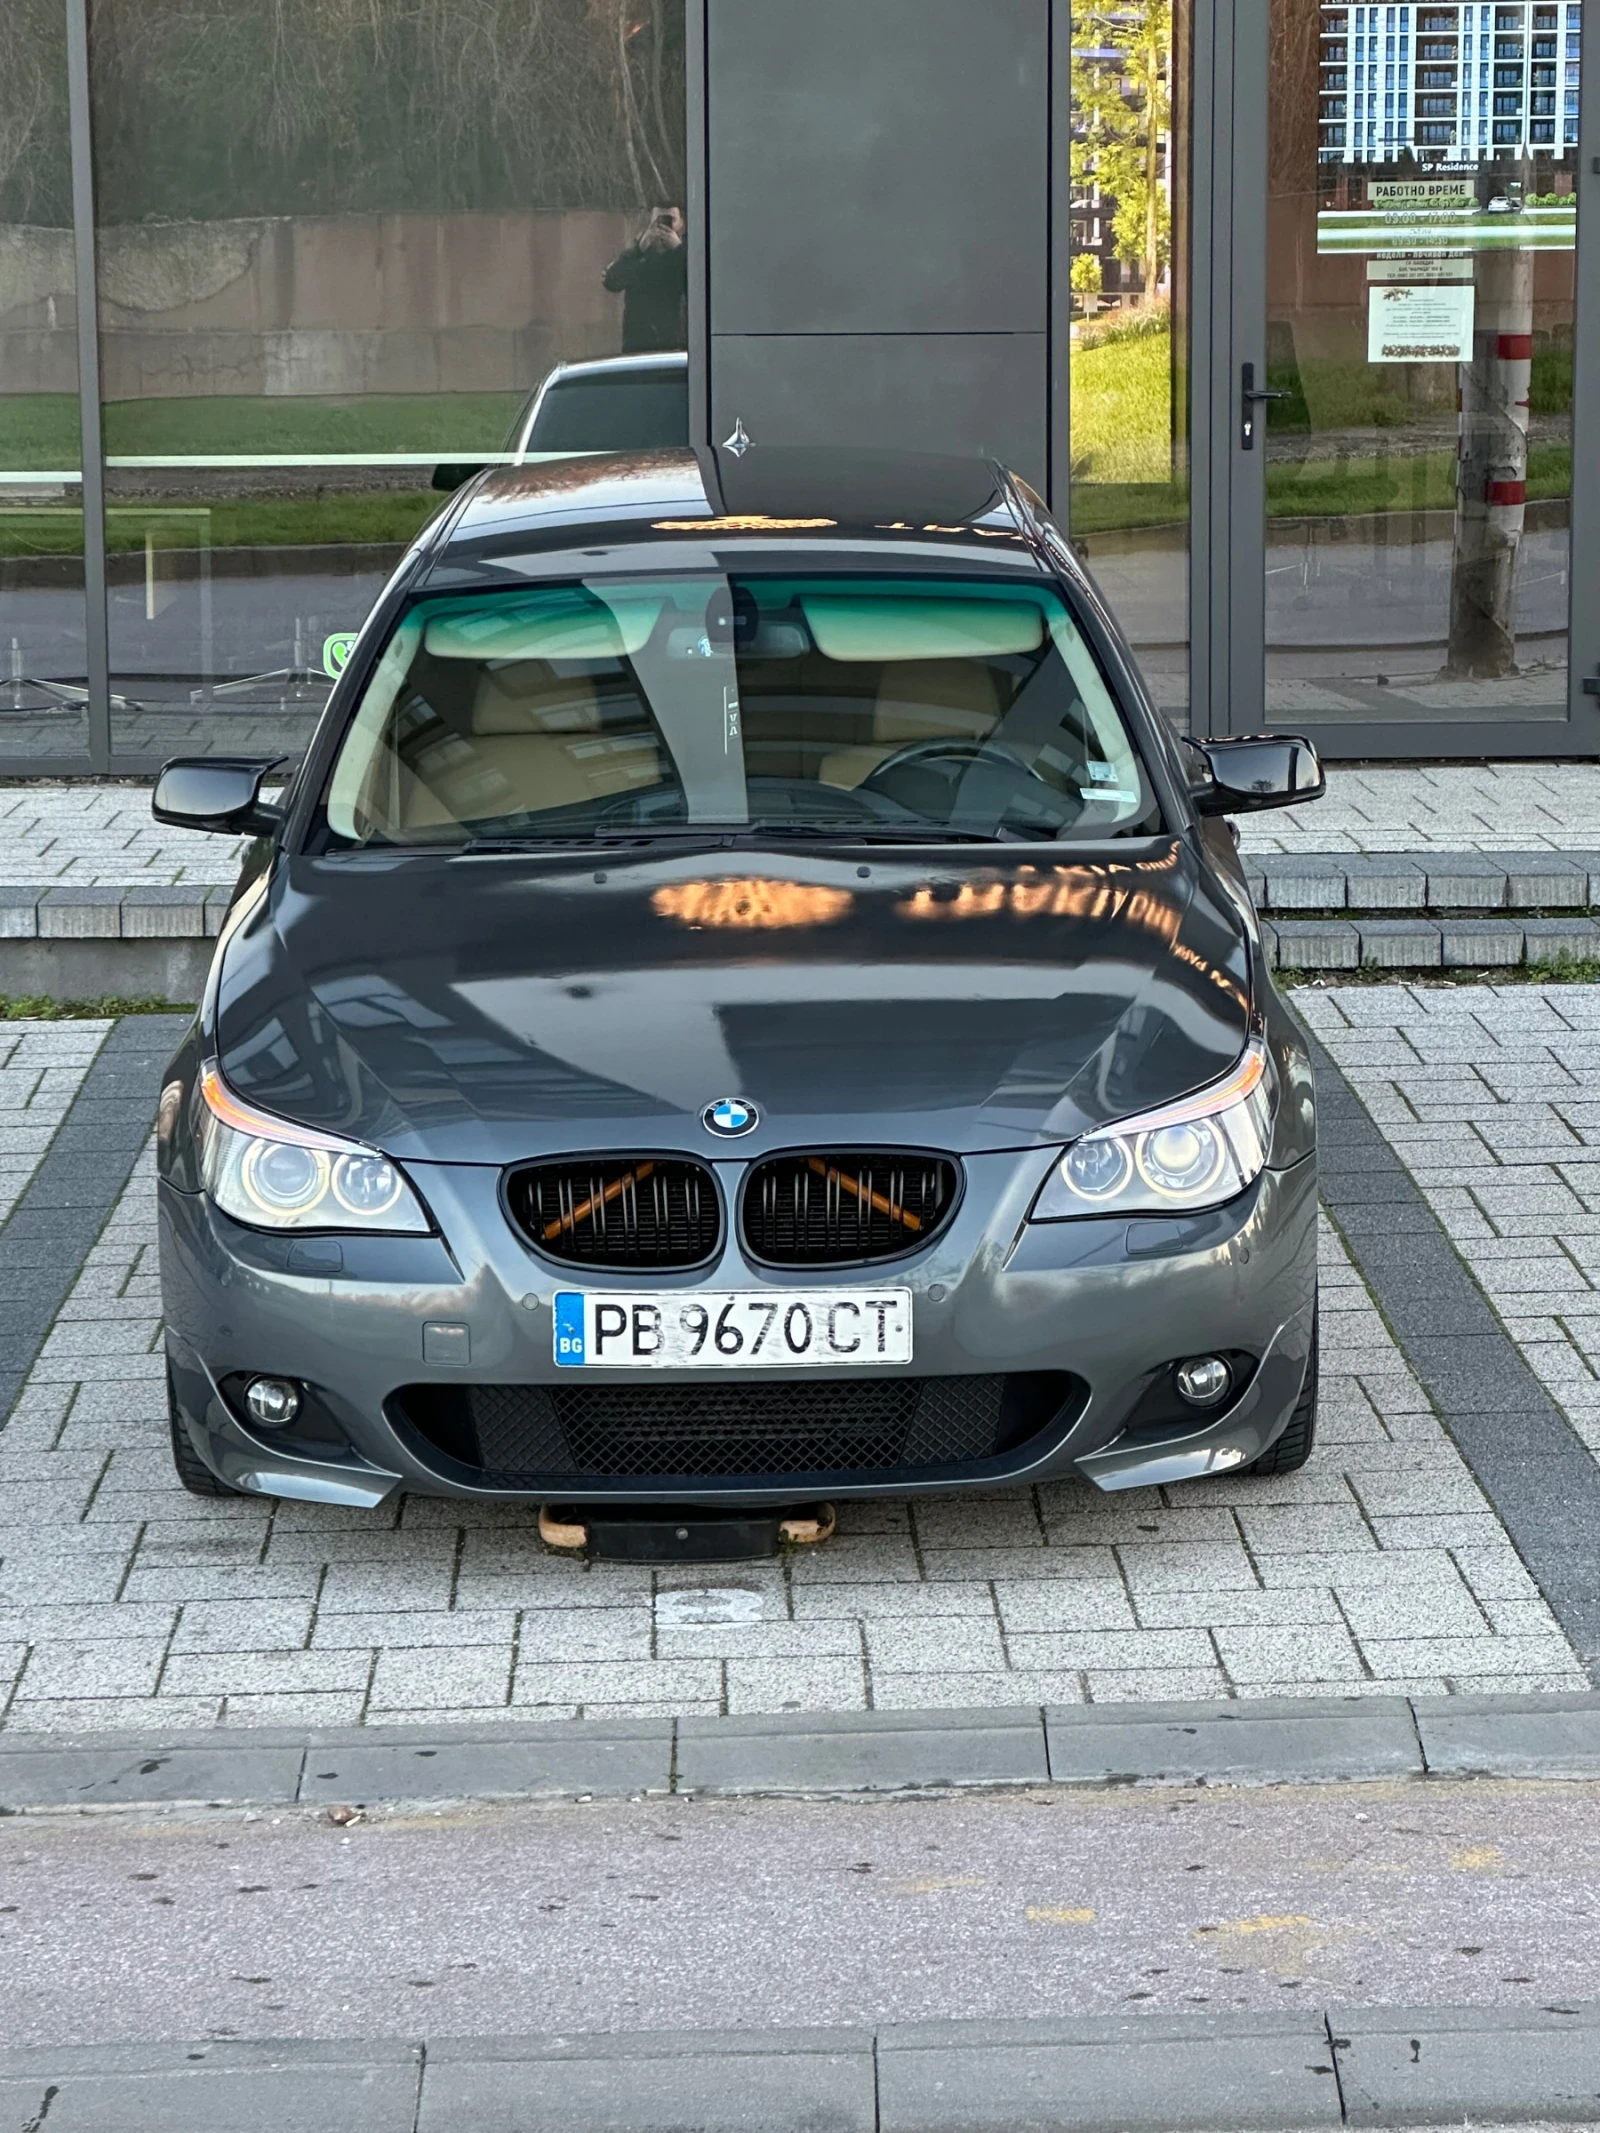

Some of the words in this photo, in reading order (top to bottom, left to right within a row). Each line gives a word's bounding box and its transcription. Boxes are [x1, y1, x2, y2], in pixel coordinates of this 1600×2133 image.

[1422, 163, 1434, 172] SP
[1436, 162, 1479, 172] Residence
[1376, 185, 1425, 197] РАБОТНО
[1428, 184, 1465, 196] ВРЕМЕ
[679, 1302, 814, 1356] 9670
[828, 1300, 898, 1354] CT
[559, 1337, 583, 1354] BG
